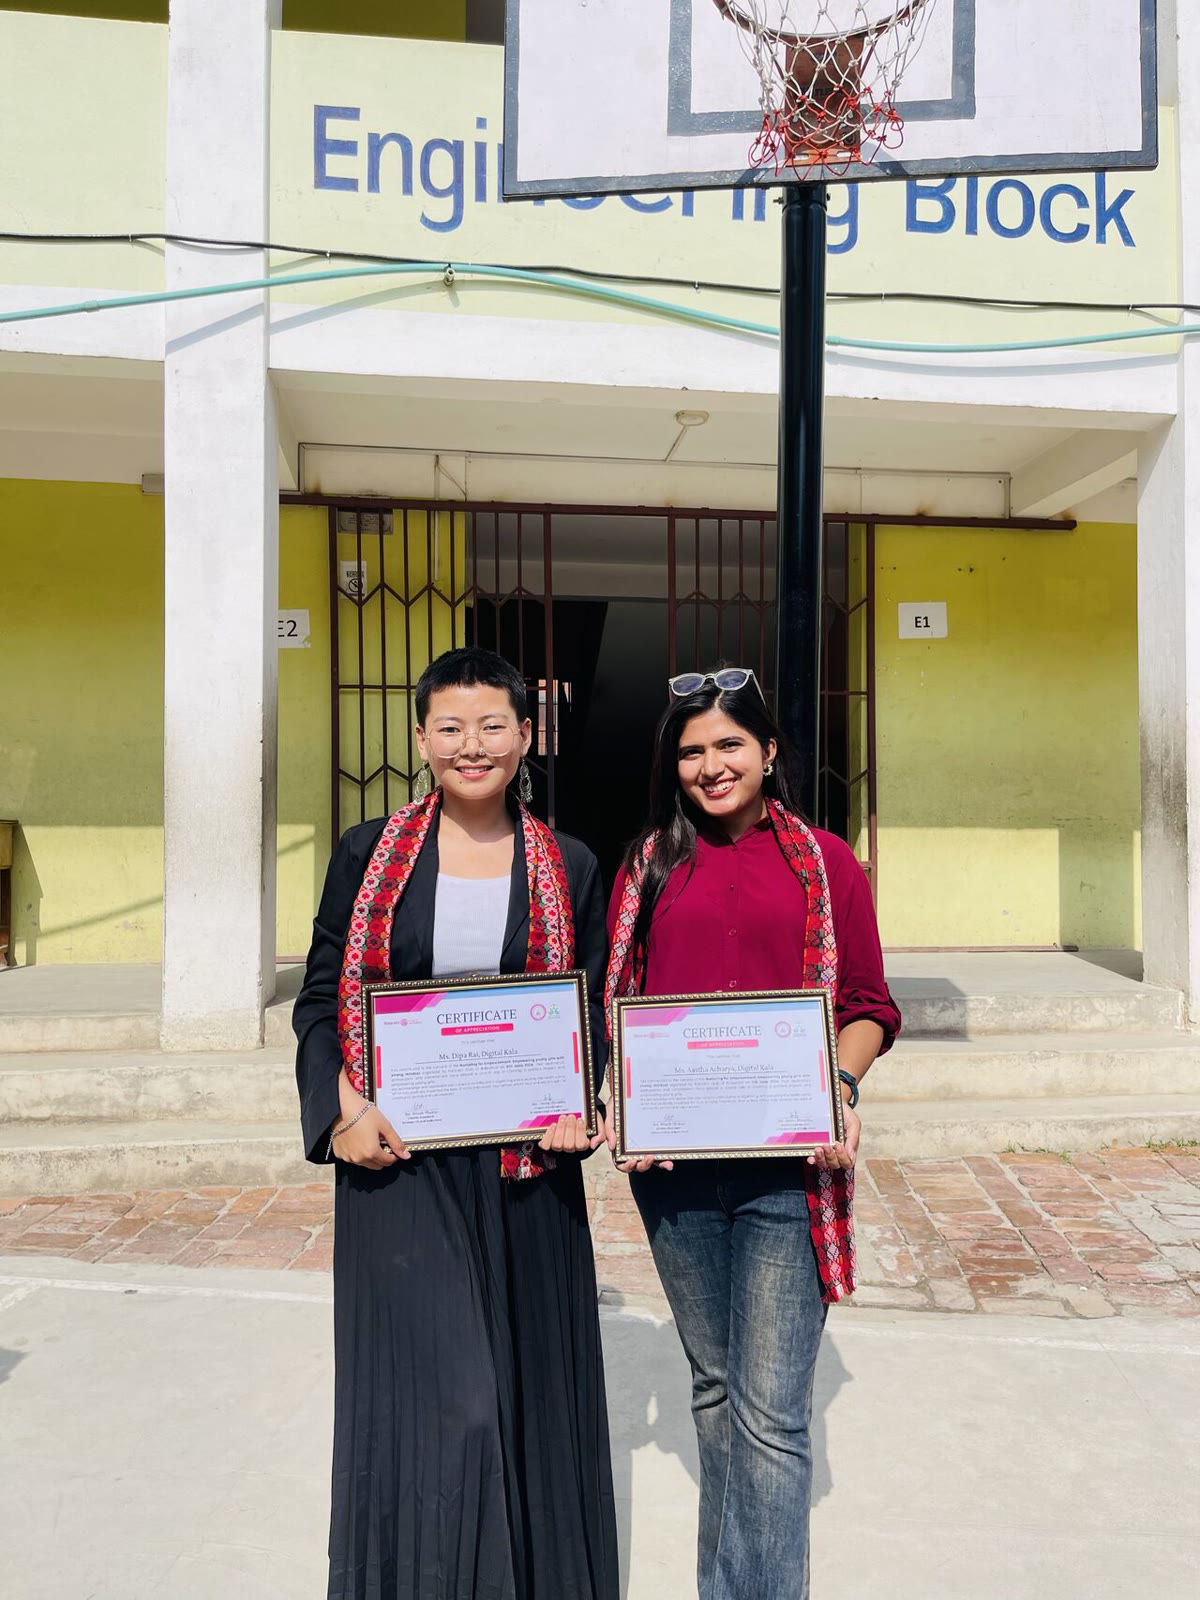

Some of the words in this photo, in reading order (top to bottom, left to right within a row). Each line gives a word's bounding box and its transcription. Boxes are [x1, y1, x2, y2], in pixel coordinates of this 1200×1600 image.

[906, 168, 1137, 248] Block
[914, 616, 931, 628] E1
[436, 1008, 518, 1025] CERTIFICATE
[682, 1025, 762, 1039] CERTIFICATE
[451, 1052, 467, 1061] Dipa
[481, 1049, 503, 1060] Digital
[503, 1048, 518, 1056] Kala
